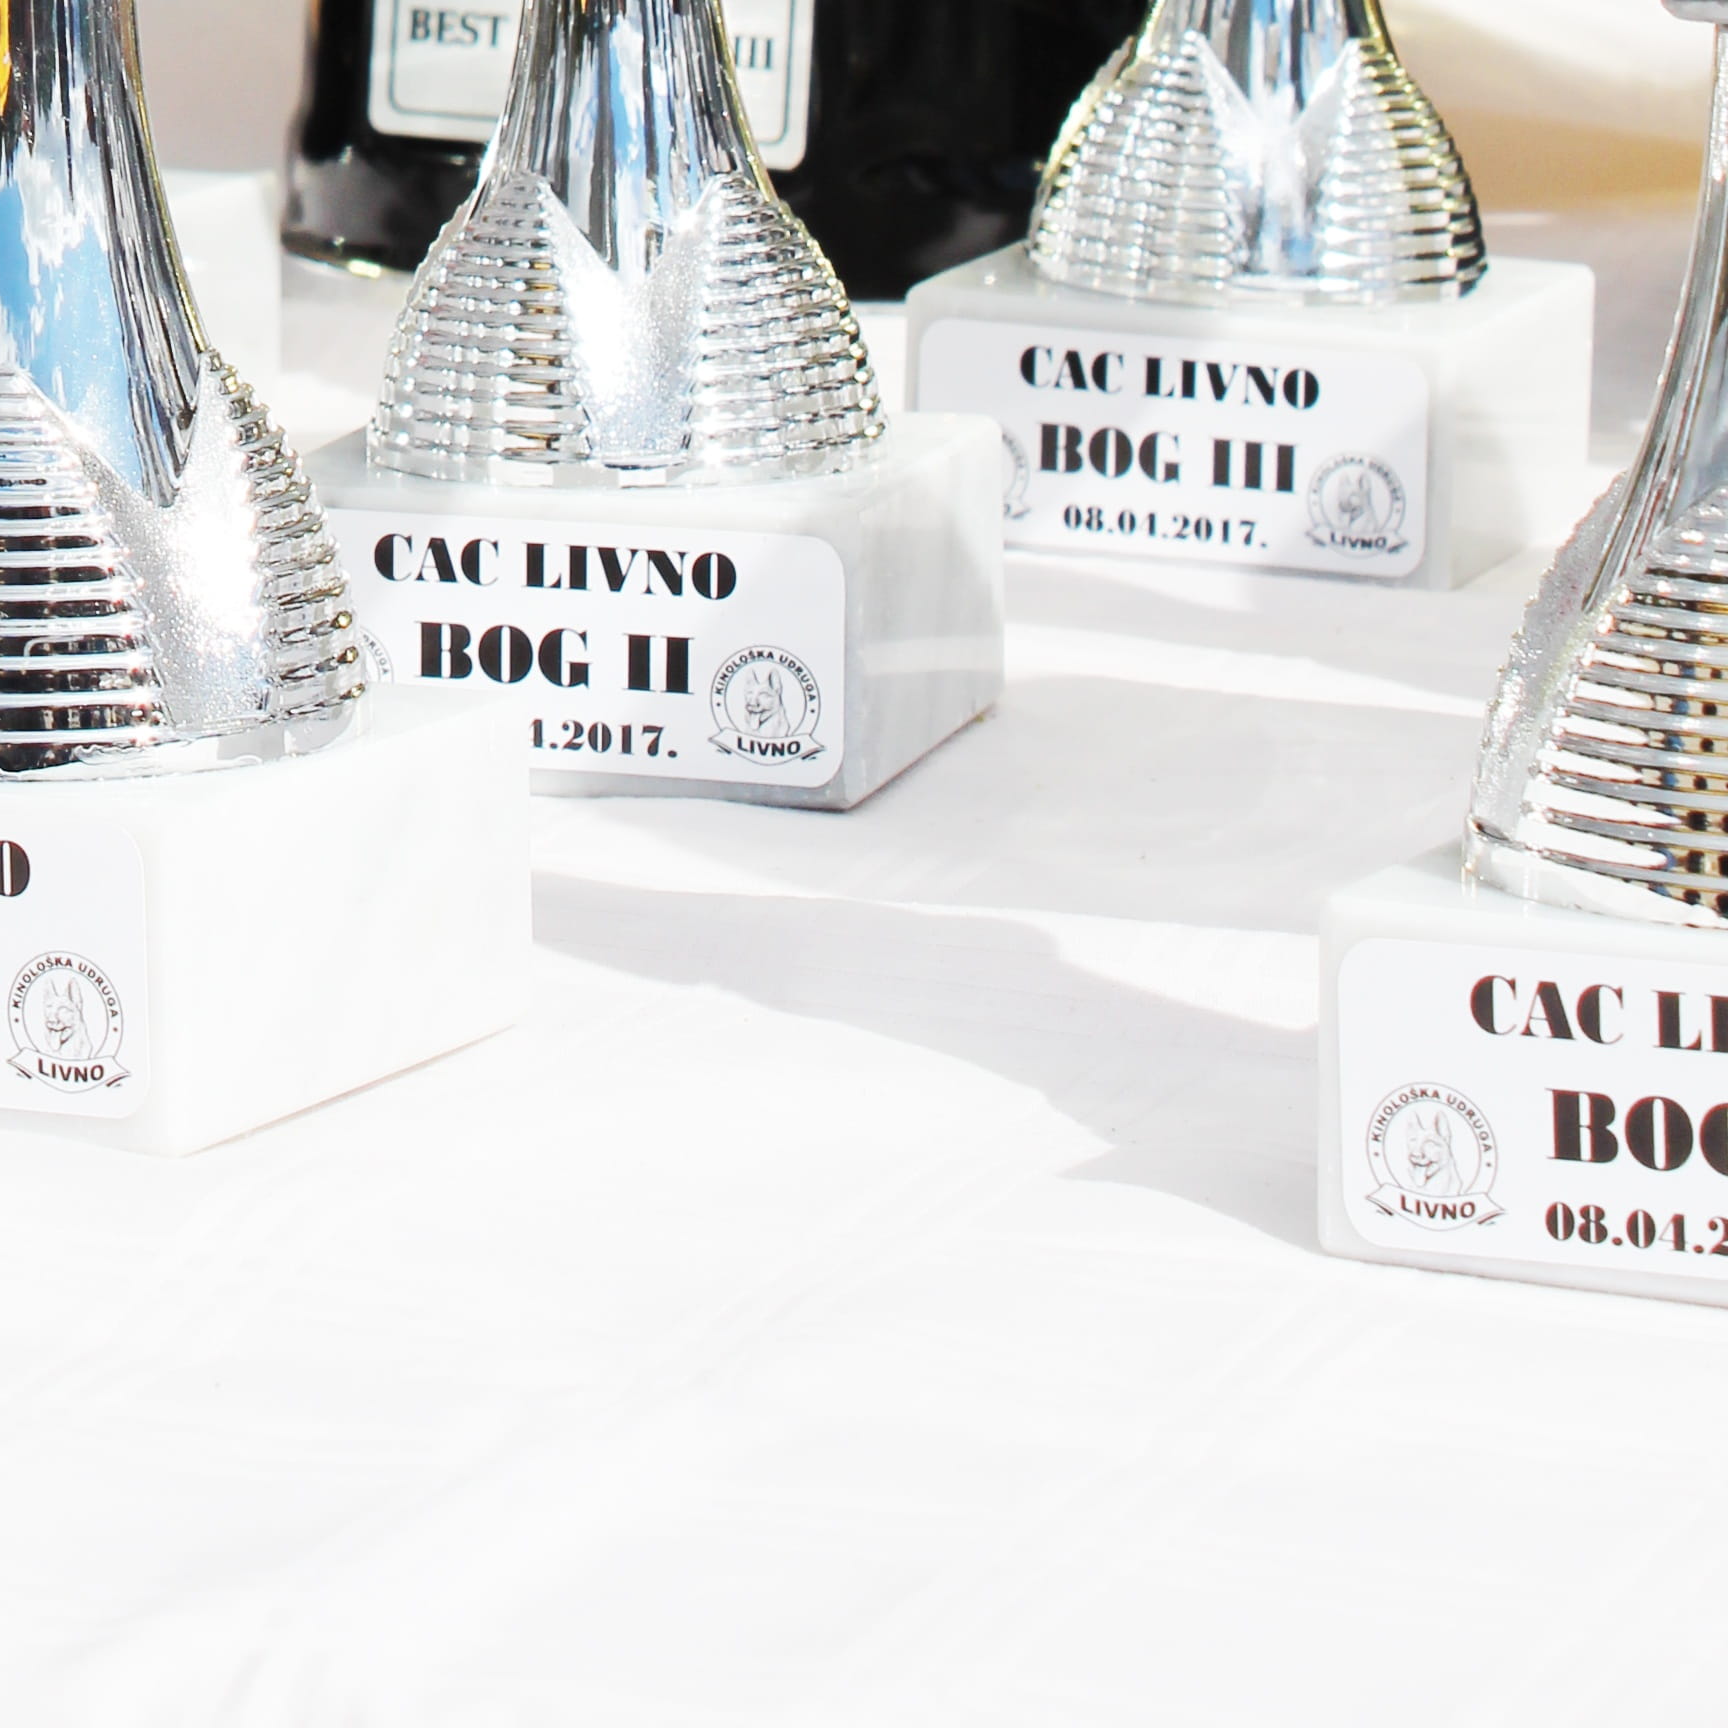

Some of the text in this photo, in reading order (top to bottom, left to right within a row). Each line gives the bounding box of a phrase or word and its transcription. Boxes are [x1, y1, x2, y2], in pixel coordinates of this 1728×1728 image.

[409, 9, 507, 48] BEST
[1019, 345, 1320, 410] CAC LIVNO
[1037, 423, 1181, 484] BOG
[1209, 438, 1297, 494] III
[1063, 504, 1268, 550] 08.04.2017.
[1331, 531, 1387, 549] LIVNO
[373, 533, 738, 600] CAC LIVNO
[413, 620, 695, 695] BOG II
[737, 736, 801, 757] LIVNO
[1470, 974, 1624, 1045] CAC
[38, 1058, 104, 1082] LIVNO
[1399, 1195, 1476, 1220] LIVNO
